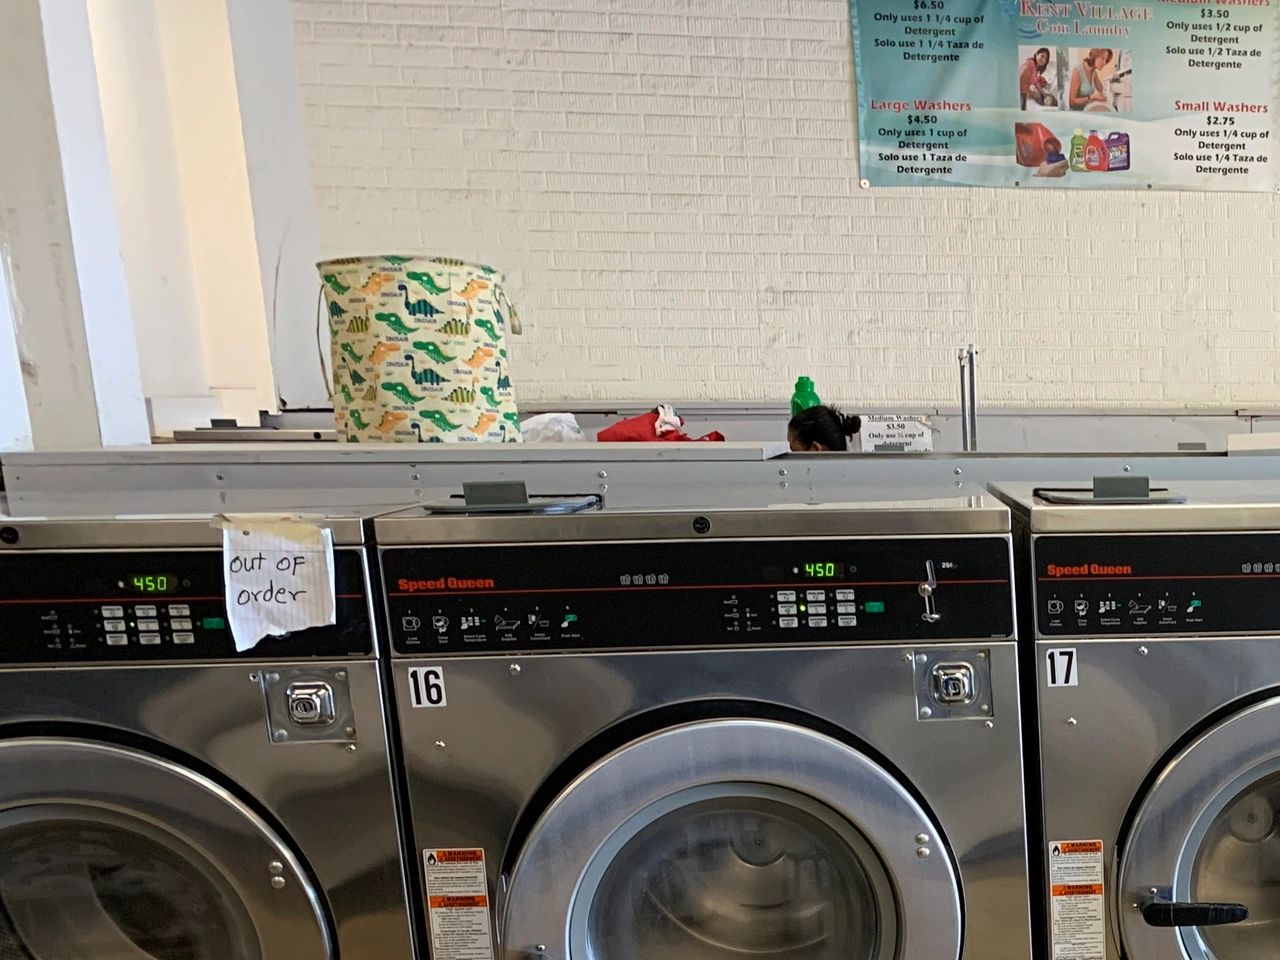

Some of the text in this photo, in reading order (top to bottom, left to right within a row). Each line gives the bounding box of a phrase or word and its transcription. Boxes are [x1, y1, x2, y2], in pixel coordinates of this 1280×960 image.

[913, 0, 944, 10] $6.50
[1020, 0, 1152, 20] KENT VILLAGE
[874, 12, 898, 24] Only
[935, 14, 951, 24] 1/4
[953, 16, 972, 26] cup
[974, 15, 984, 24] of
[1200, 8, 1230, 19] $3.50
[904, 26, 956, 38] Detergent
[1073, 20, 1131, 39] Laundry
[1166, 21, 1263, 34] Only uses 1/2 cup of
[874, 39, 896, 48] Solo
[928, 40, 944, 50] 1/4
[947, 40, 970, 49] Taza
[972, 40, 984, 49] de
[1190, 34, 1239, 46] Detergent
[1166, 46, 1186, 55] Solo
[1208, 47, 1223, 57] 1/2
[1226, 48, 1247, 57] Taza
[1250, 48, 1262, 57] de
[903, 52, 960, 63] Detergente
[1188, 59, 1242, 70] Detergente
[871, 100, 972, 113] Large Washers
[1174, 100, 1269, 113] Small Washers
[907, 115, 938, 125] $4.50
[1206, 115, 1235, 126] $2.75
[878, 128, 902, 138] Only
[937, 130, 954, 139] cup
[957, 129, 968, 137] of
[1174, 128, 1269, 140] Only uses 1/4 cup of
[898, 141, 949, 151] Detergent
[1198, 141, 1246, 151] Detergent
[878, 153, 899, 161] Solo
[930, 153, 952, 162] Taza
[955, 154, 967, 162] de
[1174, 153, 1268, 163] Solo use 1/4 Taza de
[896, 166, 953, 176] Detergente
[1195, 165, 1249, 176] Detergente
[868, 432, 884, 440] Only
[805, 563, 834, 577] 450
[1047, 563, 1132, 577] Speed Queen
[133, 577, 167, 591] 450
[398, 577, 494, 592] Speed Queen
[237, 579, 306, 605] order
[1048, 651, 1074, 685] 17
[410, 669, 443, 705] 16
